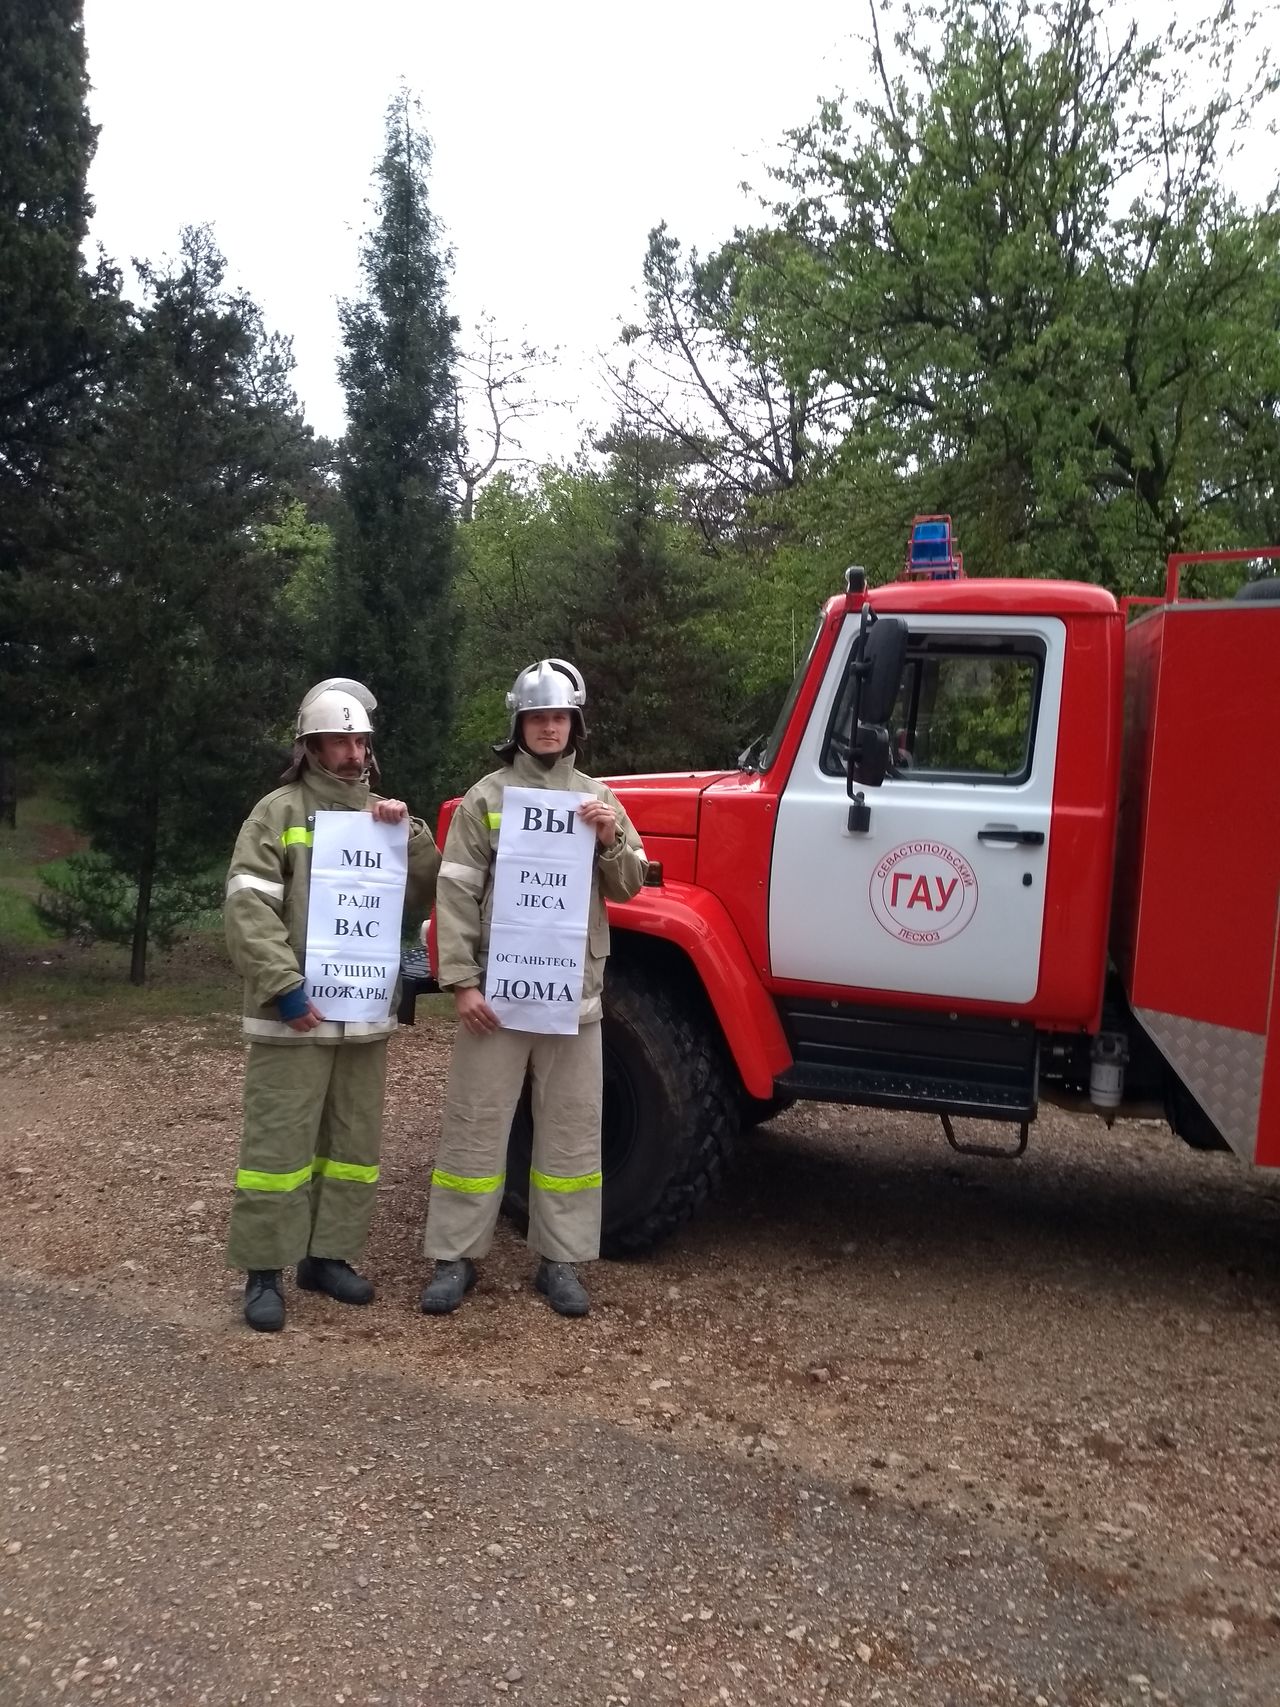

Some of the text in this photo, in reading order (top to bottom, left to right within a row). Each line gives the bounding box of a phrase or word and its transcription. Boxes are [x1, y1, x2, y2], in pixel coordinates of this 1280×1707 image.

[520, 806, 577, 835] ВЫ
[340, 849, 382, 869] МЫ
[877, 843, 975, 888] СЕВАСТОПОЛЬСКИЙ
[519, 870, 568, 887] РАДИ
[337, 893, 381, 909] РАДИ
[516, 893, 566, 910] ЛЕСА
[890, 873, 958, 912] ГАУ
[334, 918, 380, 938] ВАС
[898, 928, 941, 942] ЛЕСХОЗ
[496, 953, 577, 968] ОСТАНЬТЕСЬ
[321, 963, 387, 979] ТУШИМ
[491, 978, 574, 1002] ДОМА
